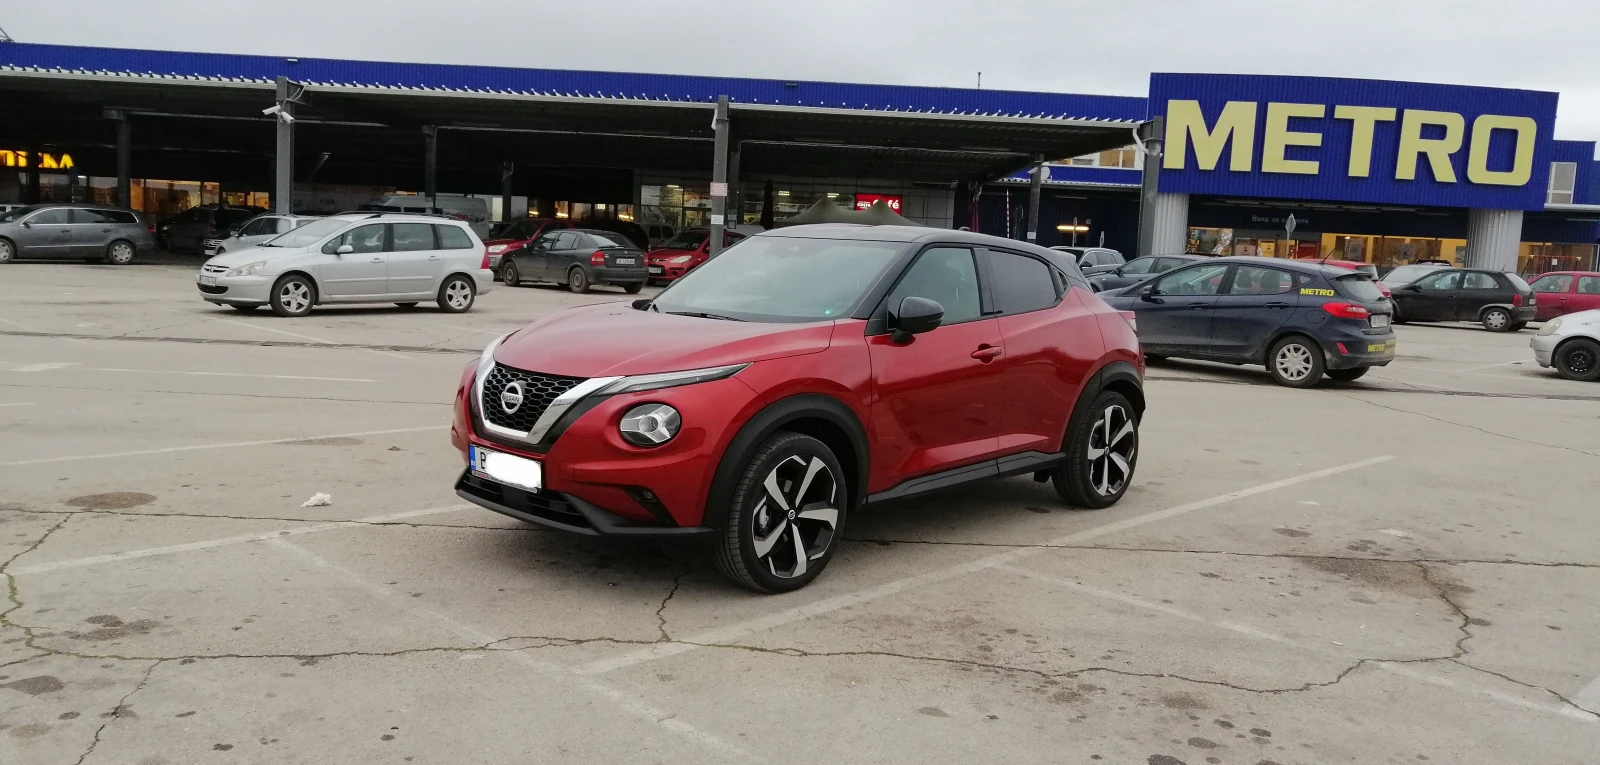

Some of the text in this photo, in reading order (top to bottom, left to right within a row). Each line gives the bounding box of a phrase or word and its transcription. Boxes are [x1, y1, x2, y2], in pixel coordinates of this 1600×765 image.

[1163, 99, 1538, 186] METRO
[1300, 288, 1334, 296] METRO
[1368, 344, 1386, 352] METRO
